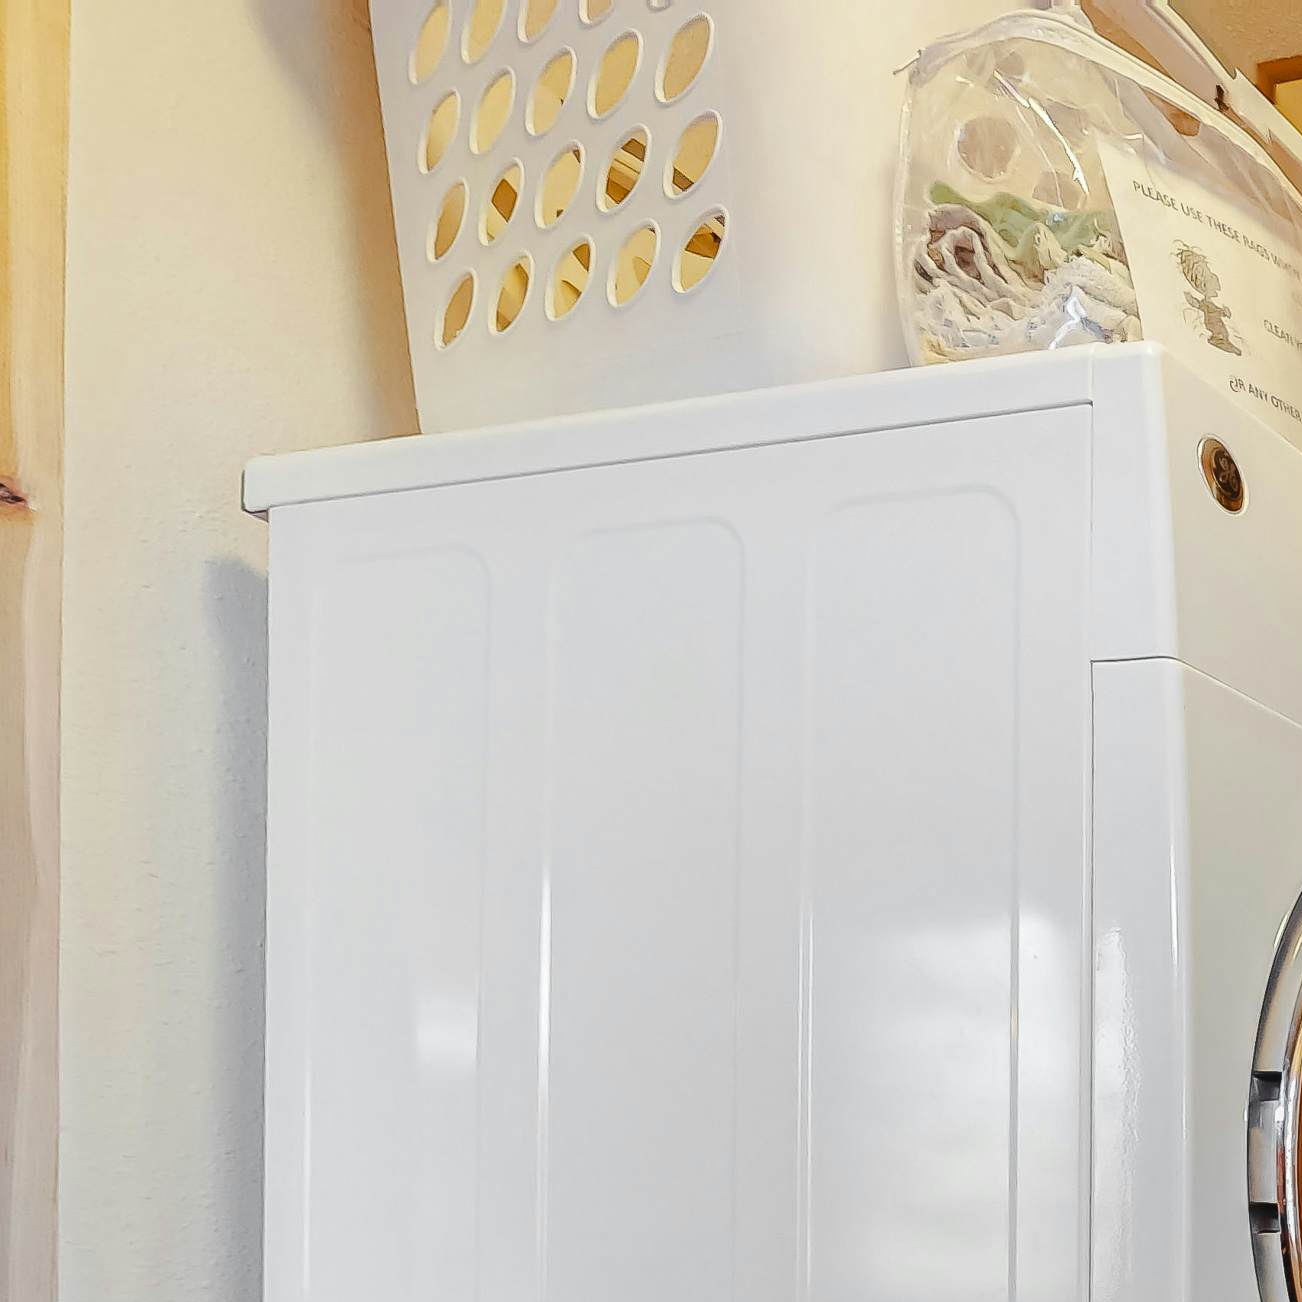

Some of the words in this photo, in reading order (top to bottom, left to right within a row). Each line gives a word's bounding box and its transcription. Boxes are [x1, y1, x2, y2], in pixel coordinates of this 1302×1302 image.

[1132, 180, 1179, 212] PLEASE
[1180, 202, 1204, 224] USE
[1205, 215, 1241, 244] THESE
[1242, 234, 1271, 262] RAGS
[1263, 319, 1296, 347] CLEAN
[1229, 377, 1246, 393] OR
[1248, 383, 1268, 402] ANY
[1270, 396, 1301, 423] OTHER
